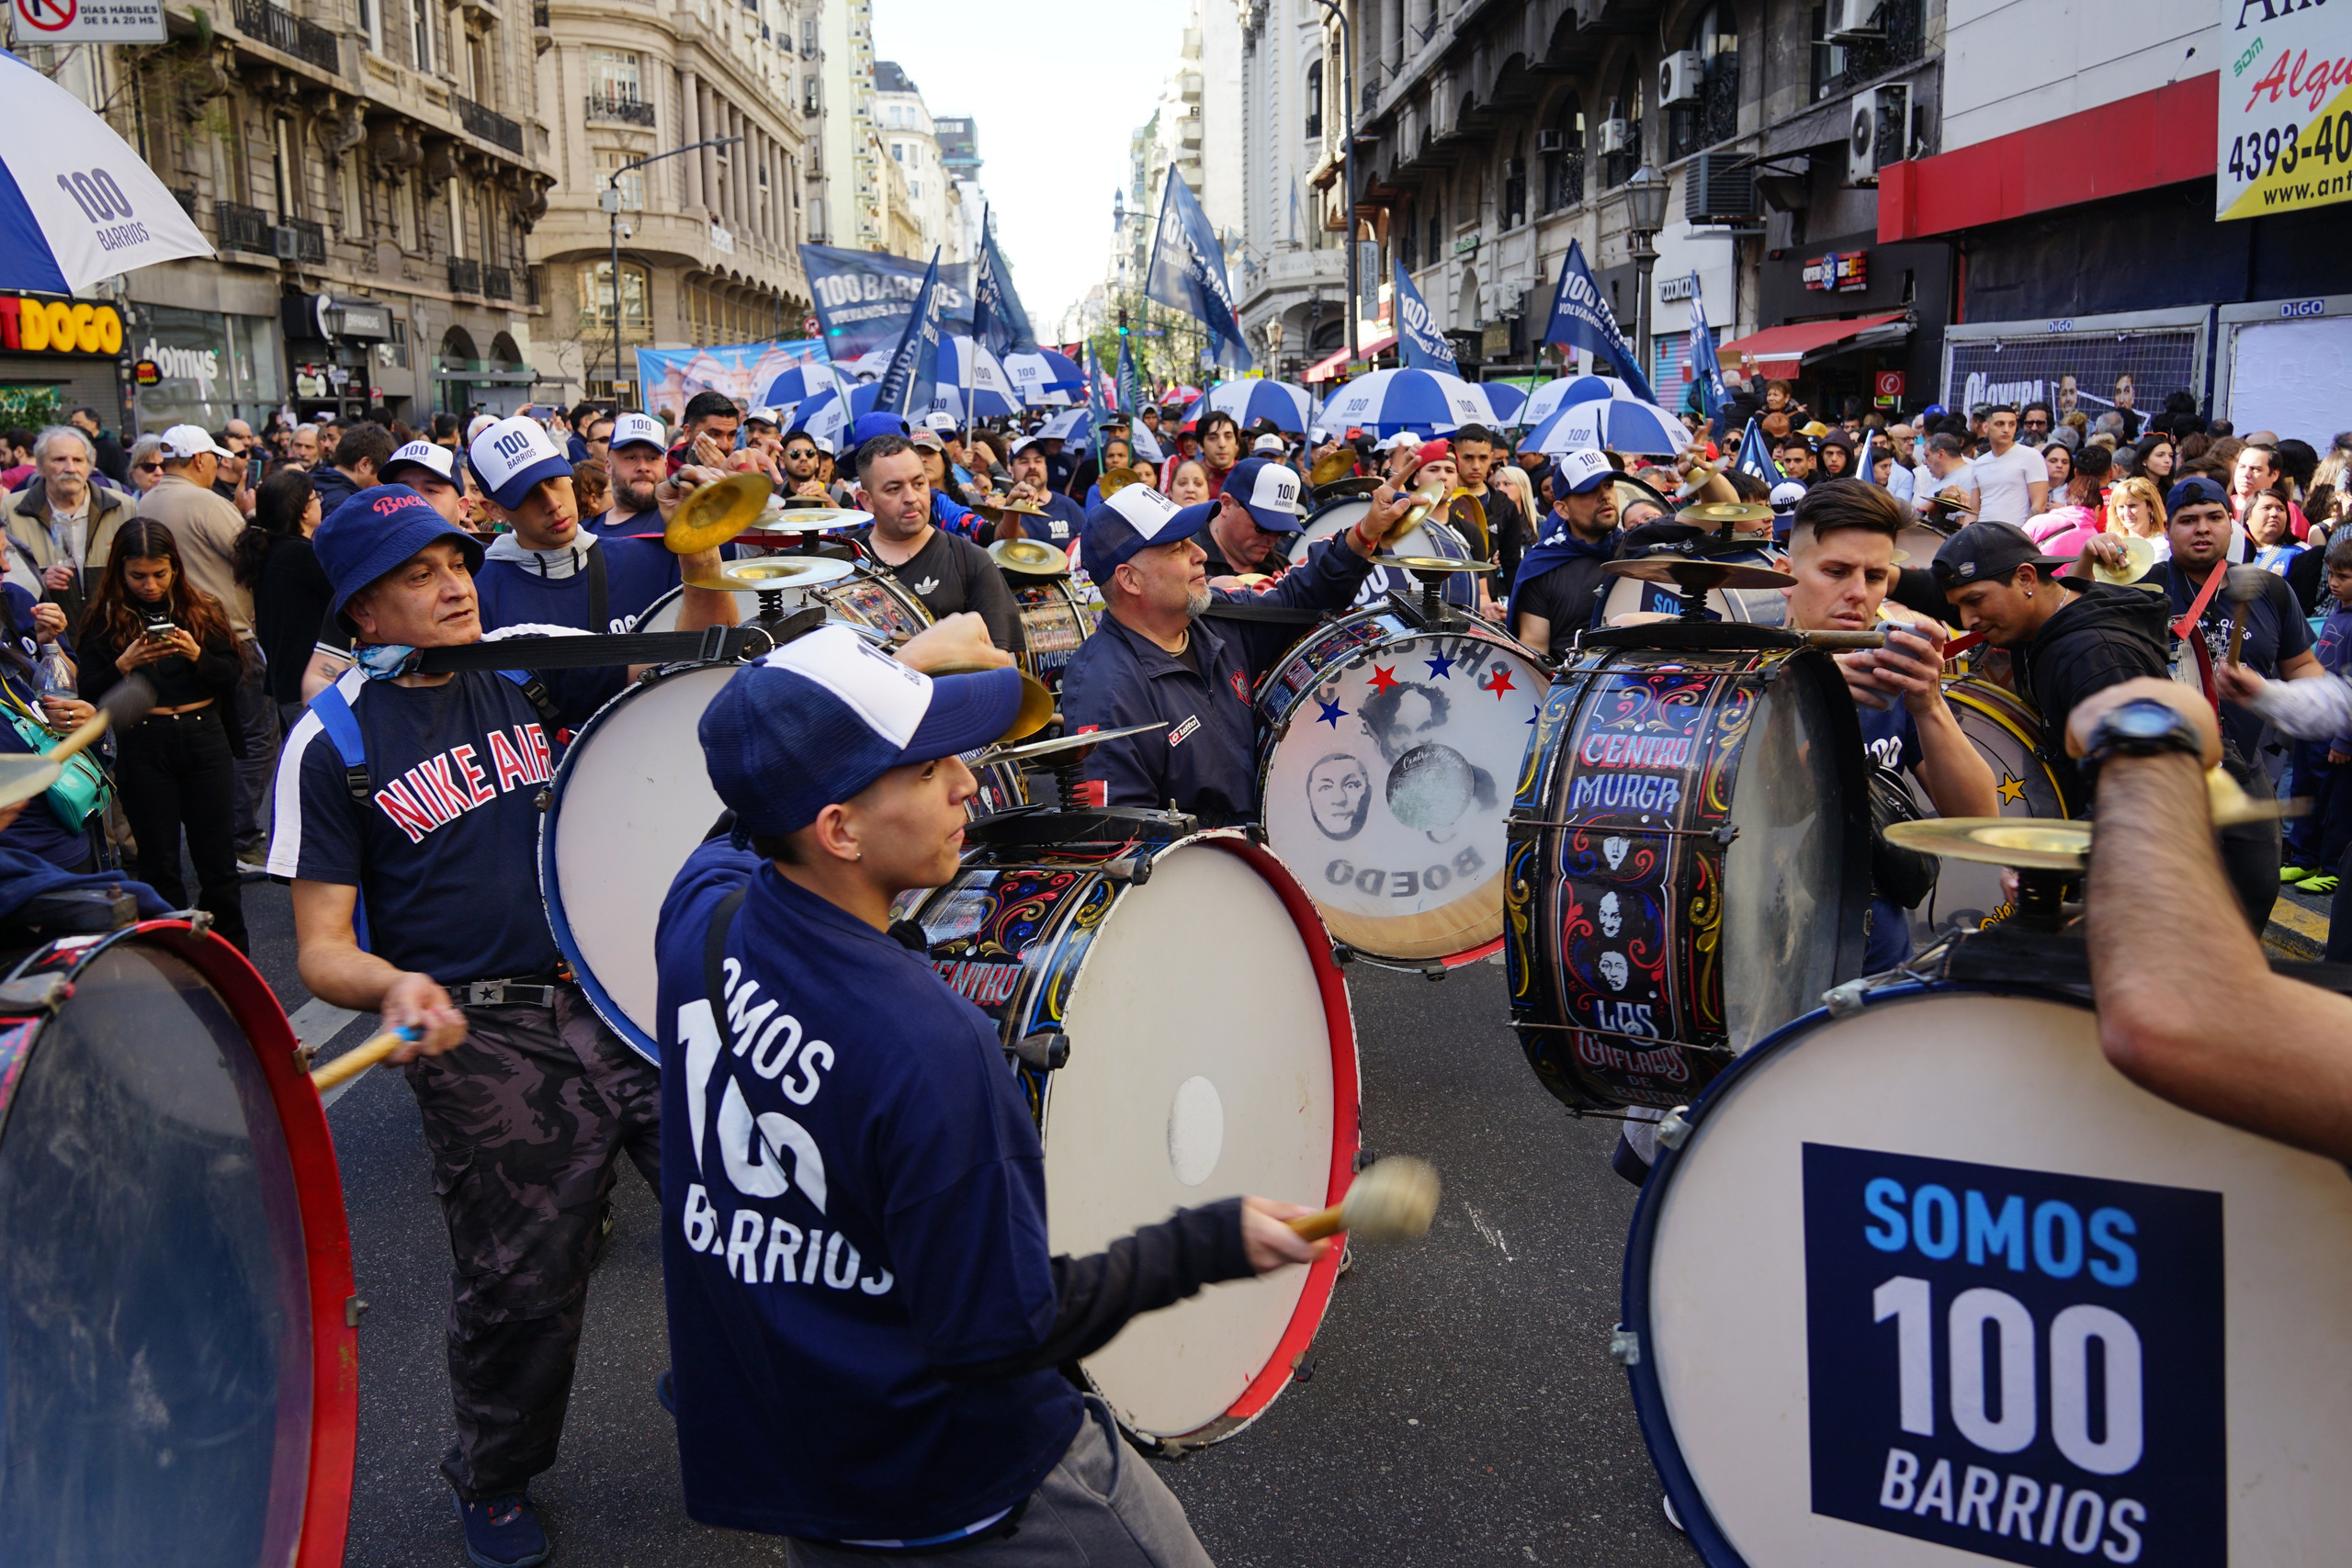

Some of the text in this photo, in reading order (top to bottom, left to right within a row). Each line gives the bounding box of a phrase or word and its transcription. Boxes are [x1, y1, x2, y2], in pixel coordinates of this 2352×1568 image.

[81, 5, 158, 15] DÍAS HÁBILES
[84, 16, 98, 24] DE
[101, 16, 108, 24] 8
[112, 16, 120, 24] A
[123, 16, 135, 25] 20
[57, 168, 133, 224] 100
[96, 220, 150, 252] BARRIOS
[813, 274, 863, 308] 100
[863, 275, 963, 309] BARROS
[1561, 271, 1597, 308] 100
[1658, 276, 1693, 303] TODOMOD
[1558, 302, 1605, 333] VOLVAMOS
[142, 337, 220, 380] domus
[975, 367, 992, 380] 100
[1017, 367, 1036, 378] 100
[1347, 398, 1369, 412] 100
[1457, 399, 1477, 413] 100
[630, 419, 652, 432] 100
[1566, 428, 1591, 442] 100
[1670, 429, 1688, 444] 100
[403, 445, 430, 457] 100
[493, 430, 531, 459] 100
[506, 447, 537, 470] BARRIOS
[1578, 452, 1601, 468] 100
[1277, 483, 1295, 501] 100
[1048, 520, 1069, 533] 100
[1581, 734, 1693, 769] CENTRO
[374, 722, 553, 844] NIKE AIR
[1571, 774, 1681, 816] MURGA
[1592, 999, 1660, 1046] LOS
[1626, 1074, 1653, 1088] DE
[1863, 1177, 2139, 1288] SOMOS
[1871, 1274, 2145, 1476] 100
[1879, 1447, 2148, 1565] BARRIOS
